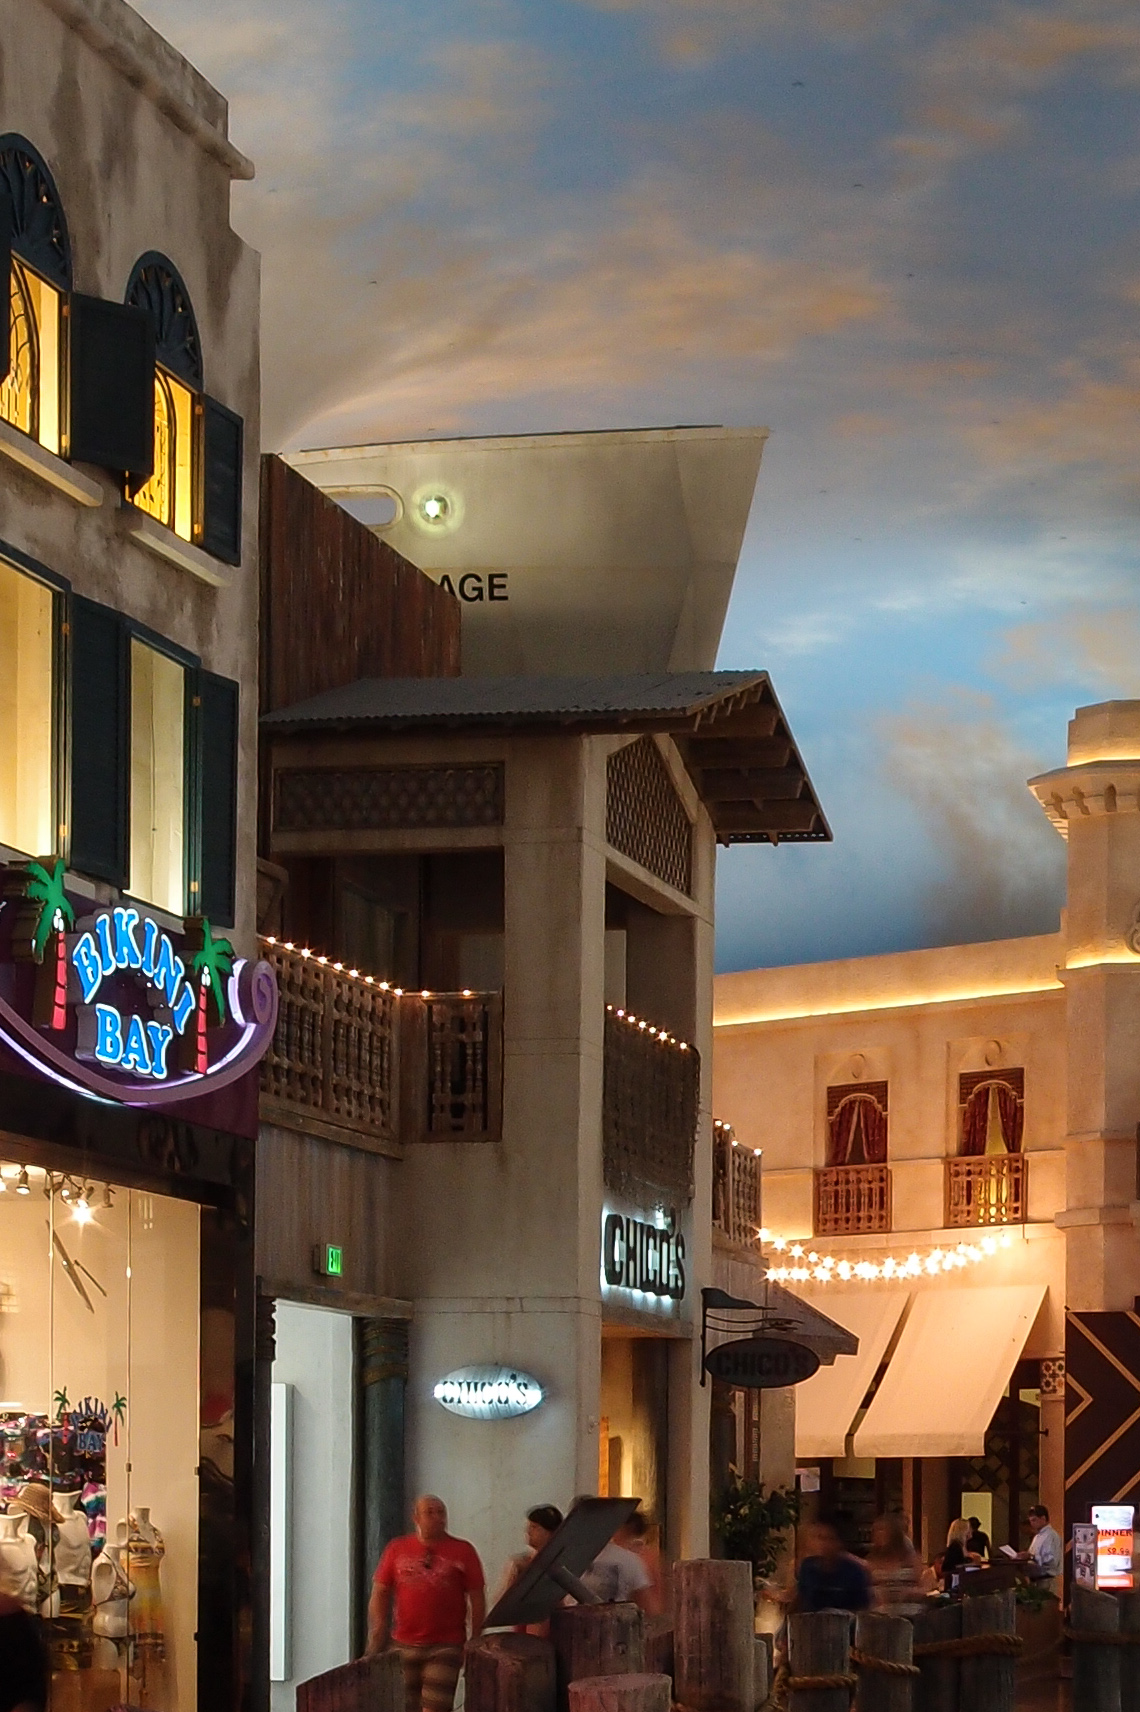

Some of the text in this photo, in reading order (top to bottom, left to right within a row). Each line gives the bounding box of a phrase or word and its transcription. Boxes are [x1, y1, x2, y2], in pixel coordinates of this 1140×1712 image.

[73, 907, 196, 1035] BIKINI
[95, 1003, 173, 1079] BAY
[604, 1207, 686, 1301] CHICO'S
[441, 1372, 528, 1405] CHICO'S
